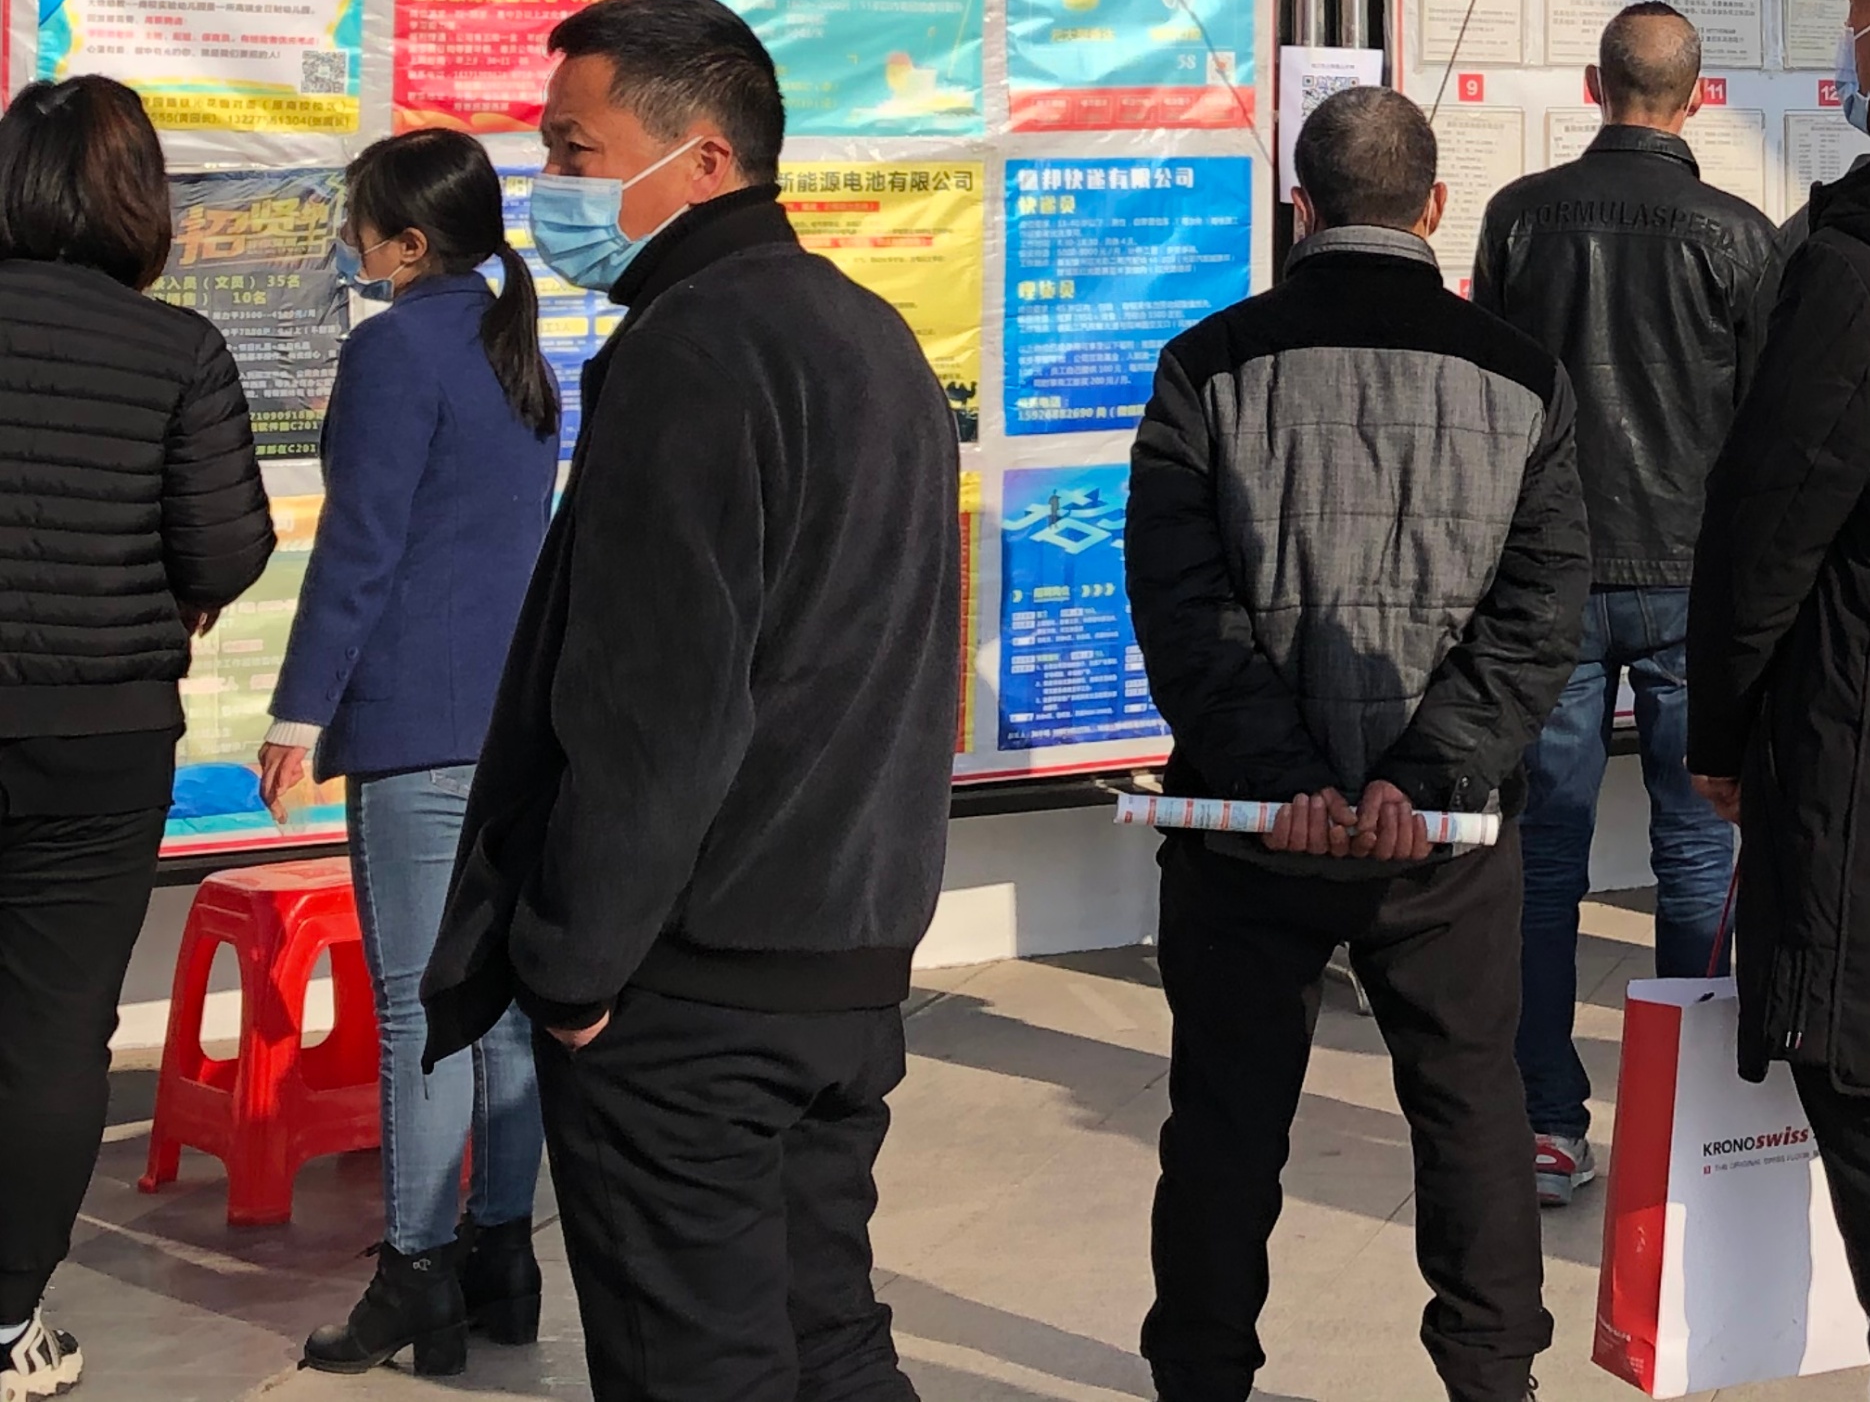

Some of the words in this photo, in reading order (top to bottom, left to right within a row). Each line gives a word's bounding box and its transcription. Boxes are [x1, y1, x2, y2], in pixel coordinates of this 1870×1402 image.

[1466, 80, 1478, 96] 9
[1707, 83, 1723, 100] 11
[1821, 85, 1839, 100] 12
[267, 274, 300, 288] 35名
[233, 291, 267, 305] 10名
[1702, 1125, 1809, 1157] KRONOswiss
